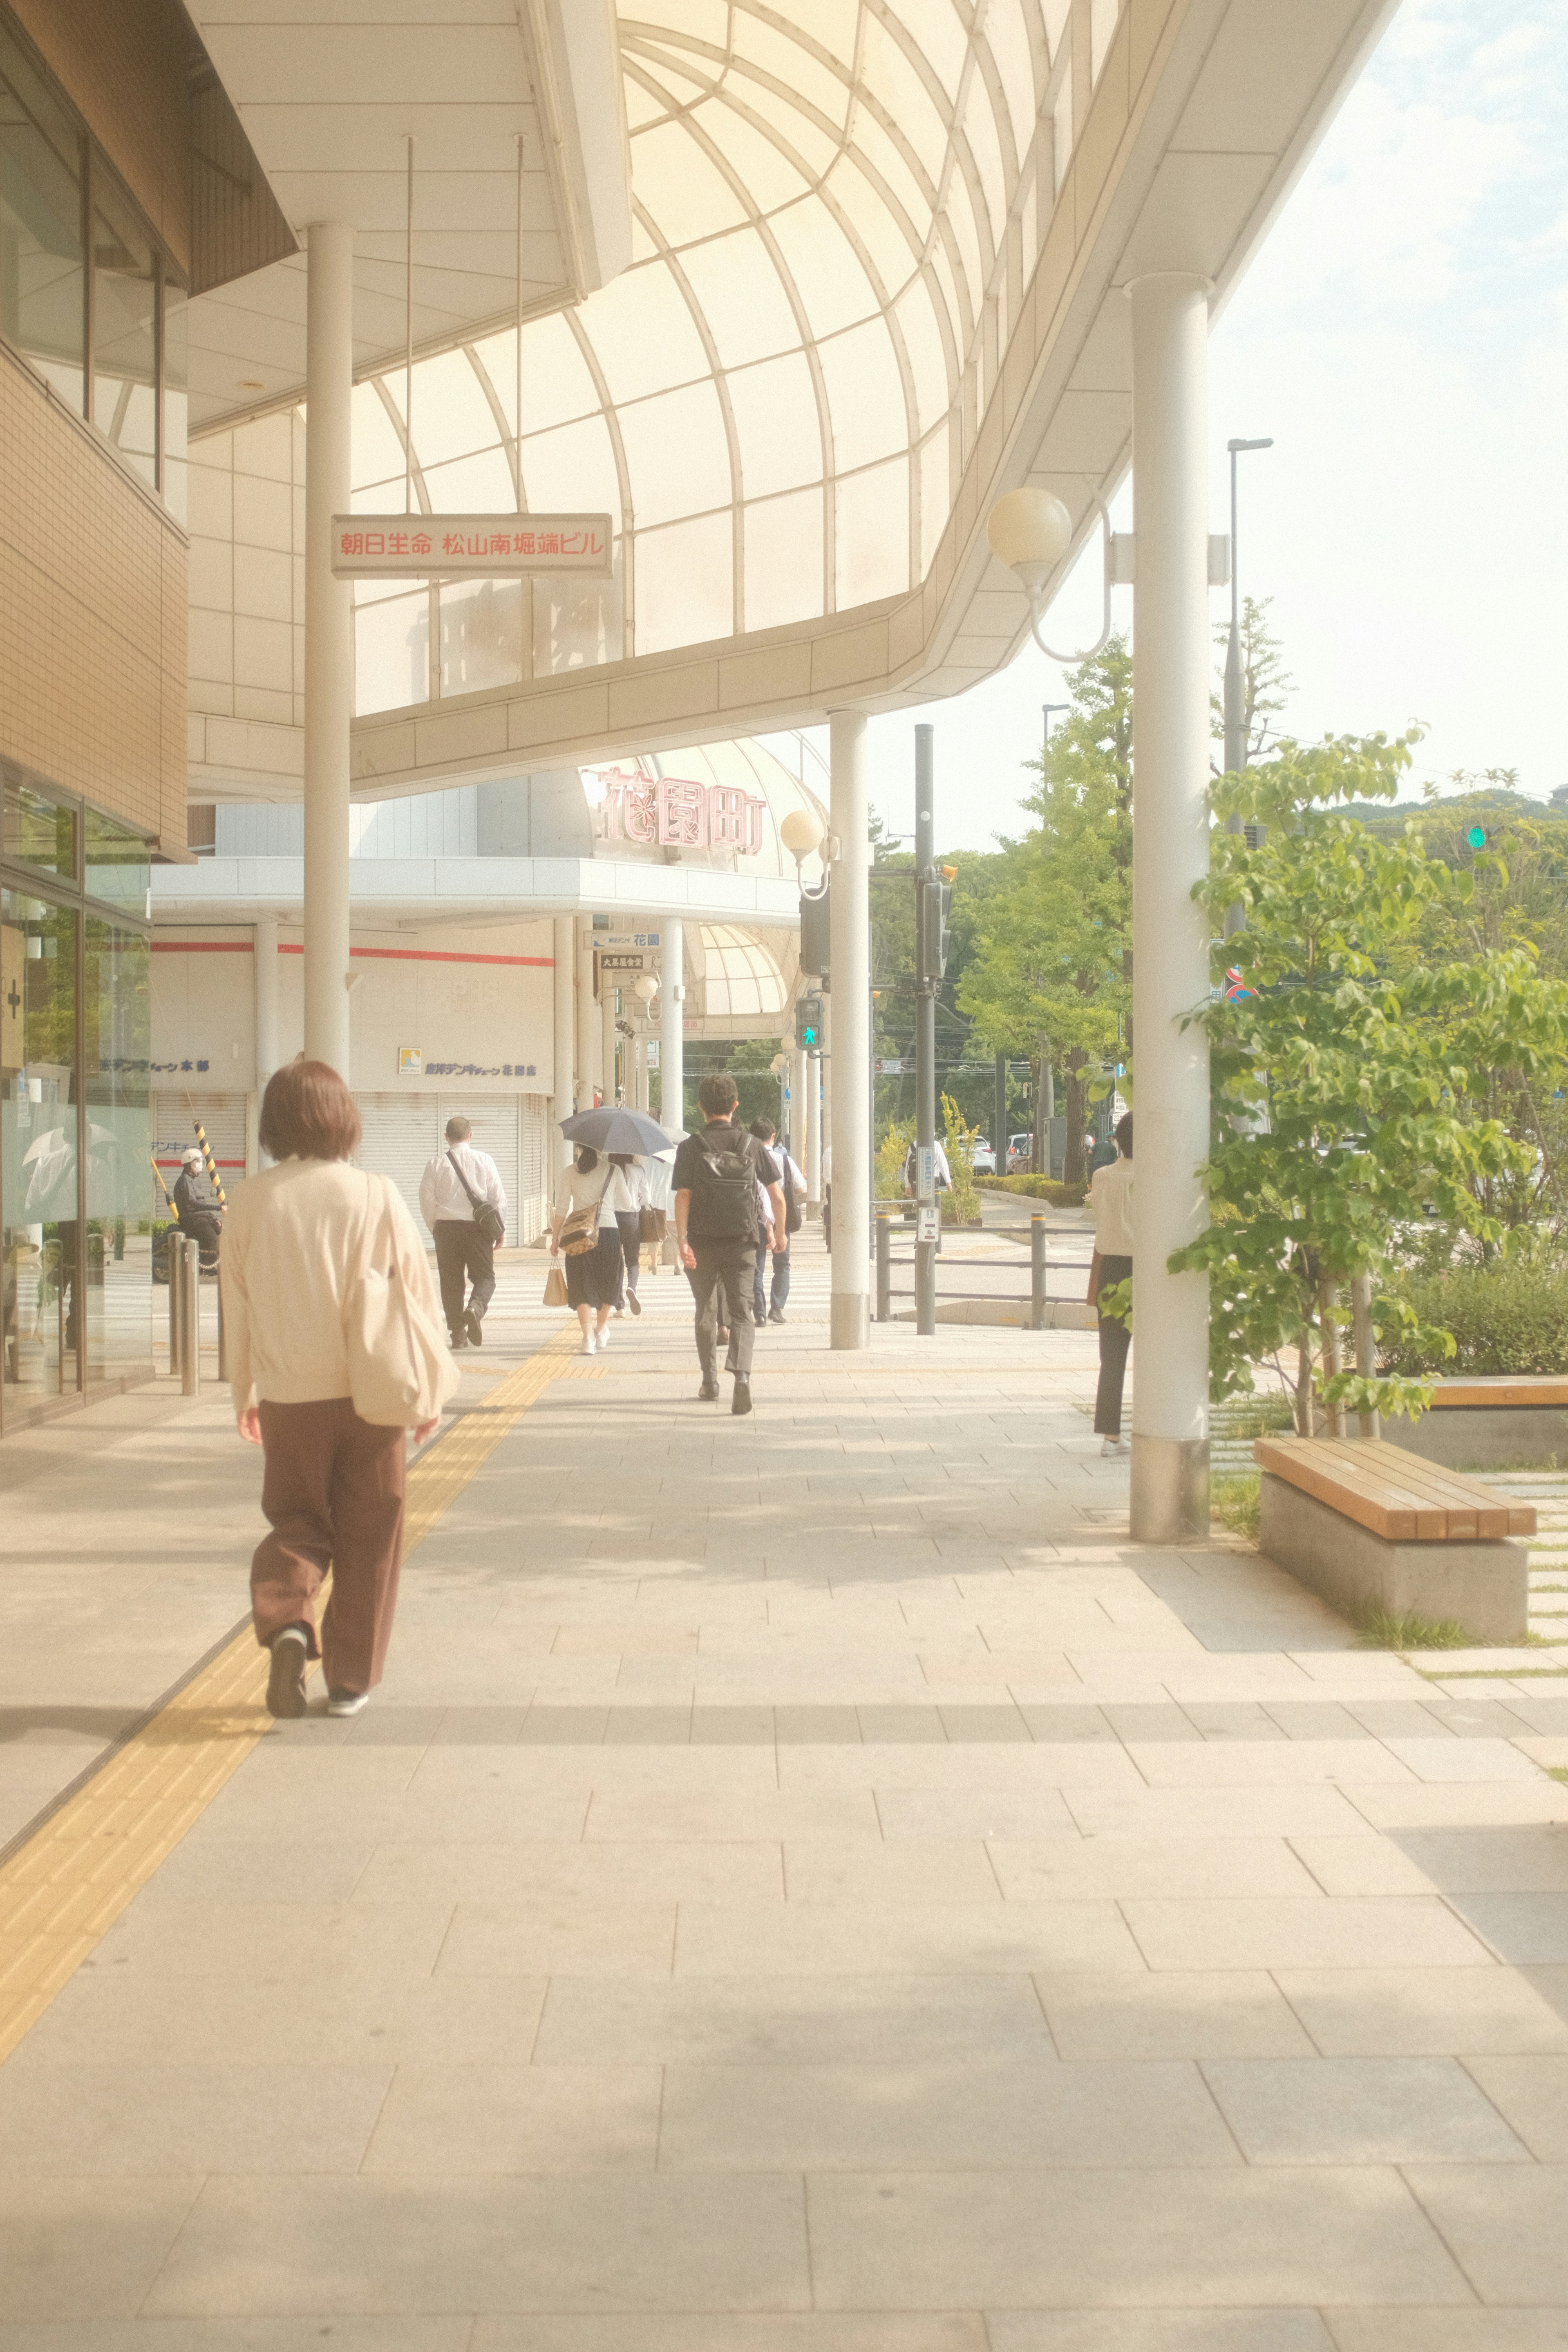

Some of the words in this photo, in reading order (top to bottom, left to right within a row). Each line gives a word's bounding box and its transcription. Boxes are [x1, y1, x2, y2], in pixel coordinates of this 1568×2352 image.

[340, 532, 433, 556] 朝日生命
[442, 532, 603, 556] 松山南堀端ビル
[598, 767, 766, 856] 花園町
[603, 957, 642, 967] 大黒屋食堂
